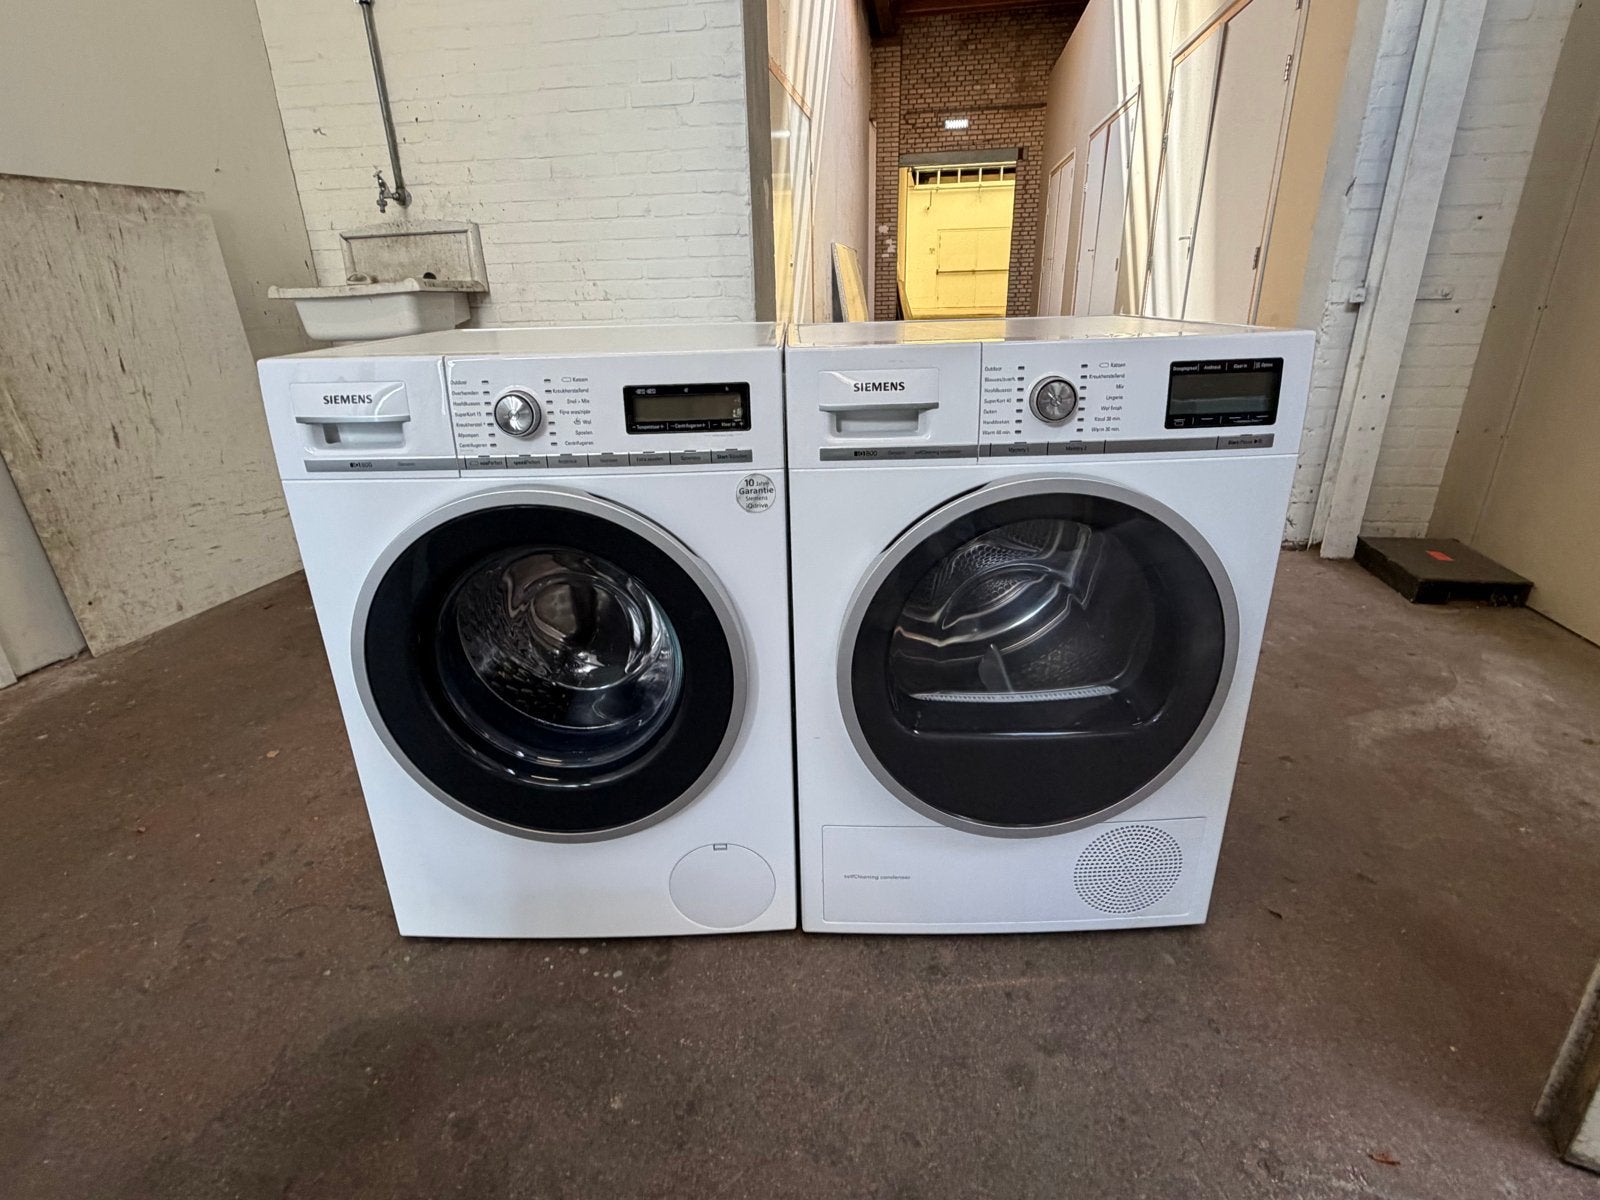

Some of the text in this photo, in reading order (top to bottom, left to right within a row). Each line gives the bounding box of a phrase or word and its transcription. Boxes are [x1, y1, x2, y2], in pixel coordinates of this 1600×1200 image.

[853, 381, 906, 393] SIEMENS
[322, 394, 373, 405] SIEMENS
[744, 478, 755, 487] 10
[738, 486, 774, 495] Garantie
